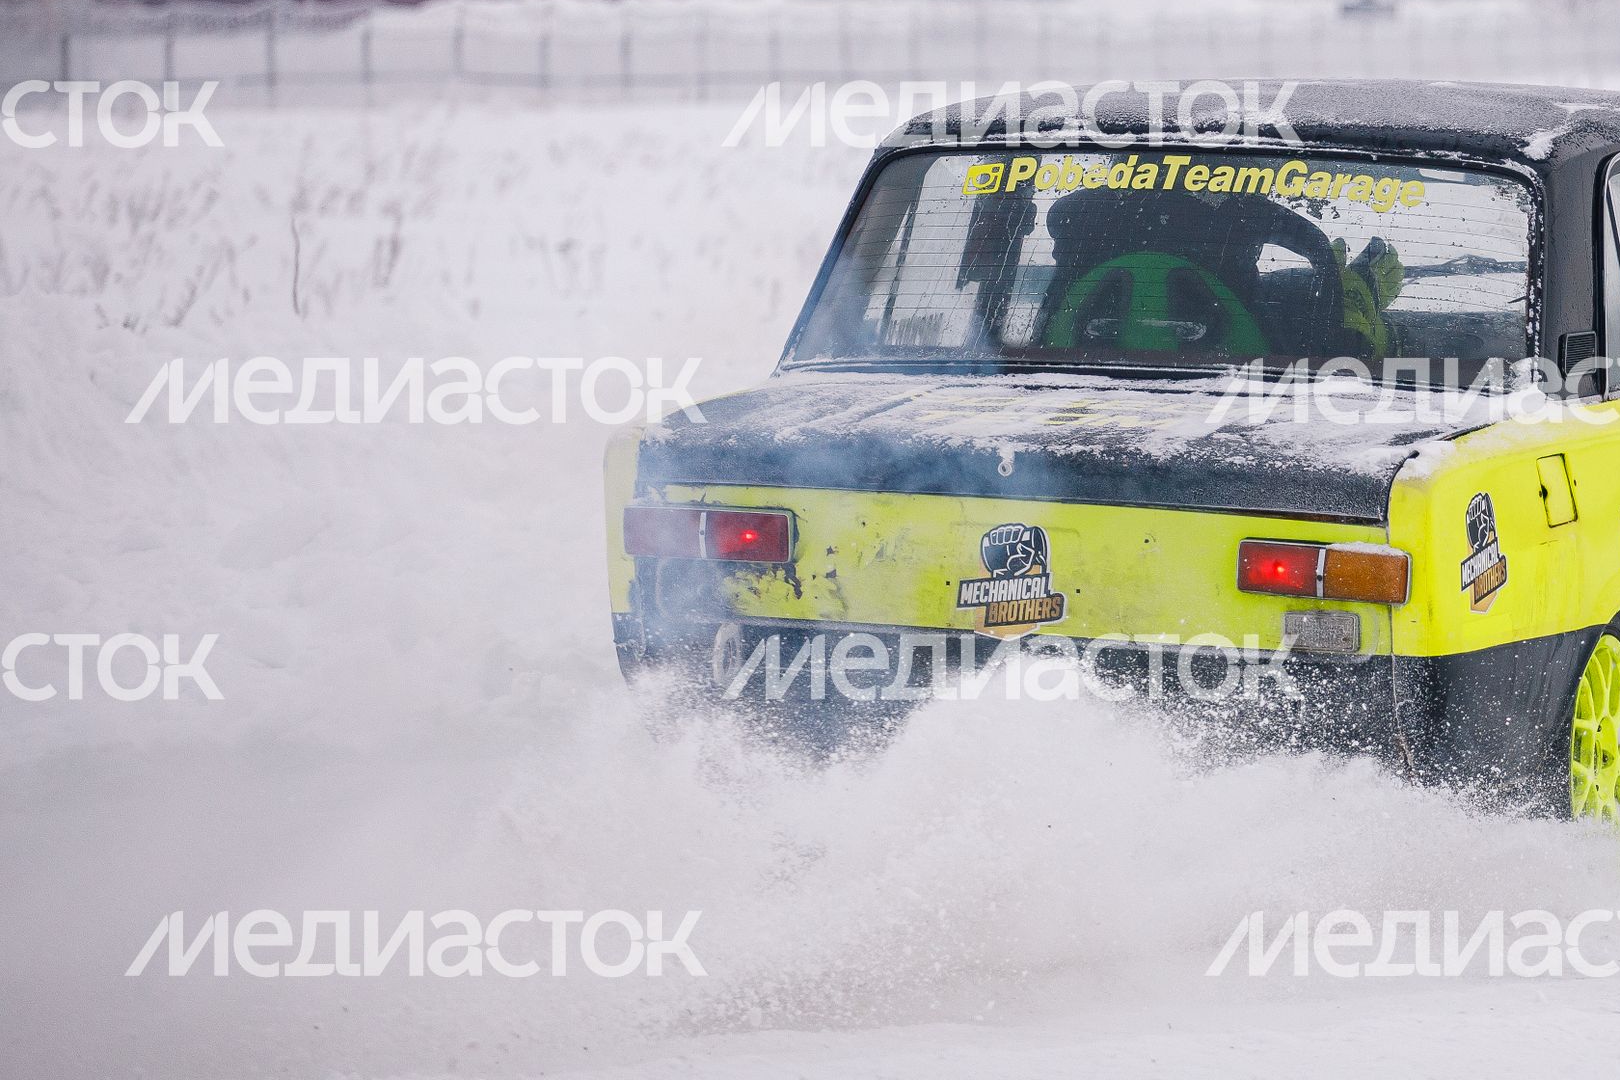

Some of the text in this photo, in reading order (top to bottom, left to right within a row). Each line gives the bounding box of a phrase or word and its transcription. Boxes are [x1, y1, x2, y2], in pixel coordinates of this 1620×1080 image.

[1005, 154, 1426, 213] PobedaTeamGarage
[959, 576, 1047, 605] MECHANICAL
[988, 596, 1061, 623] BROTHERS
